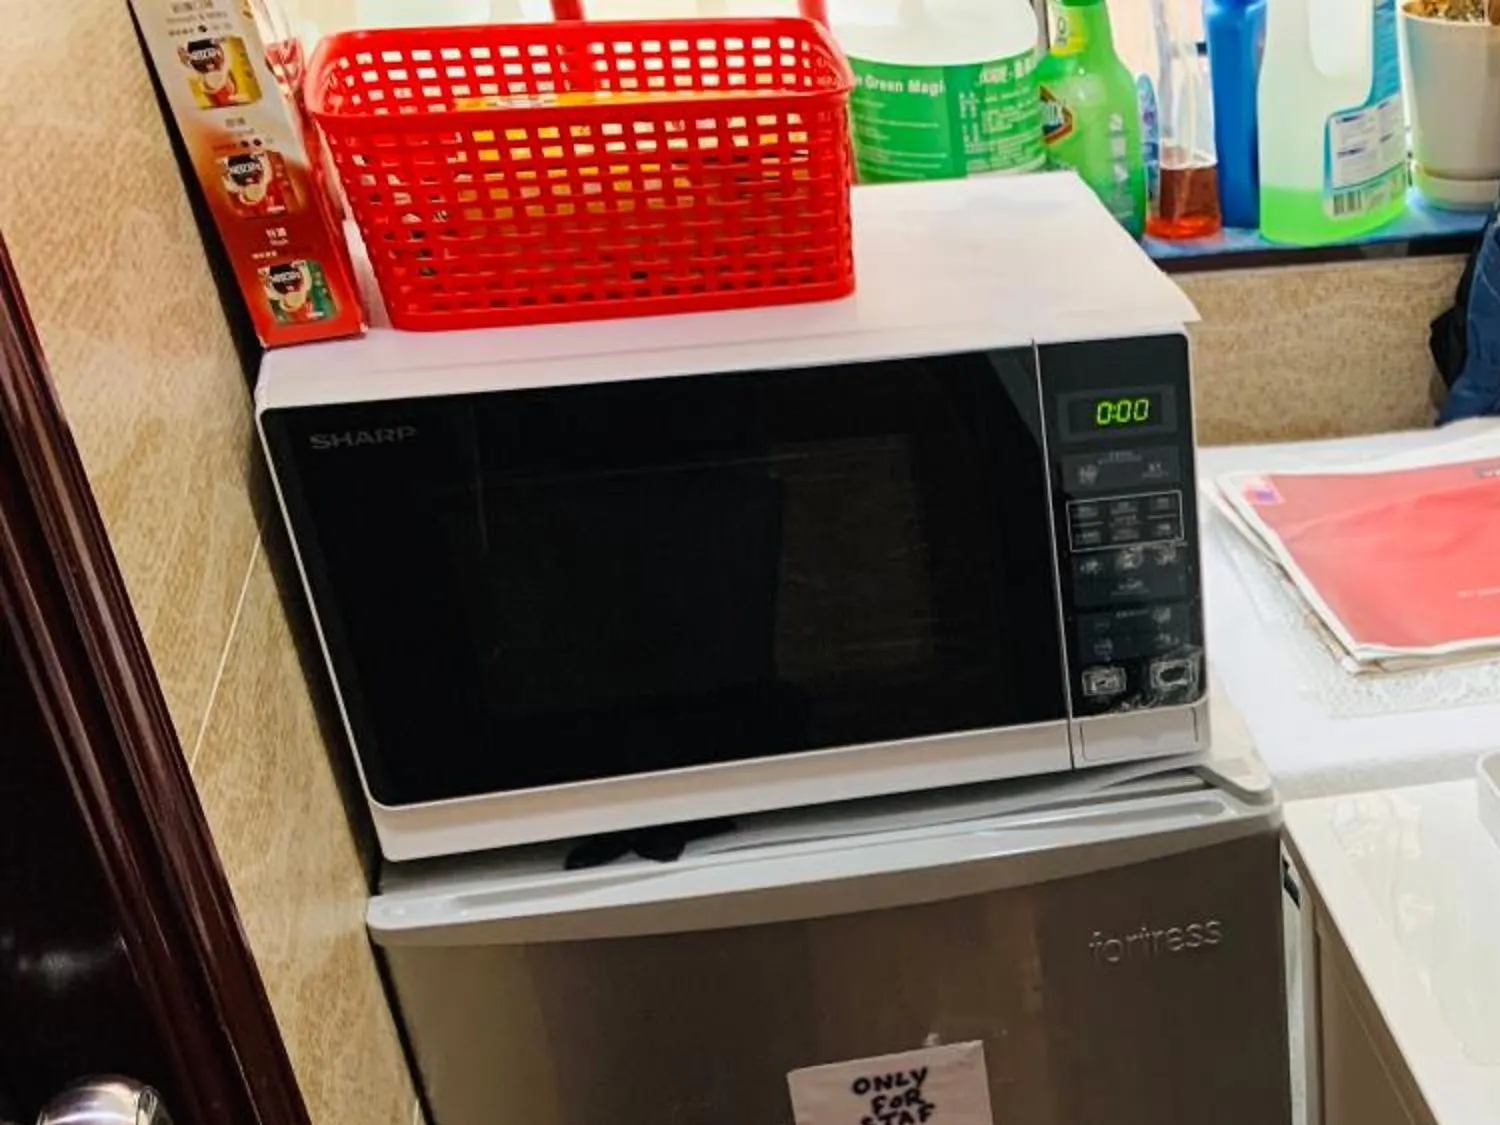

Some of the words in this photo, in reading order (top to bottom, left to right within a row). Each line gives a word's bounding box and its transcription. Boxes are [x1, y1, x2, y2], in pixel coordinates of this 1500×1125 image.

[865, 74, 904, 93] Green
[1097, 398, 1149, 426] 0:00
[308, 425, 417, 450] SHARP
[1088, 919, 1223, 963] fortress
[852, 1065, 929, 1096] ONLY
[871, 1087, 926, 1116] FOR
